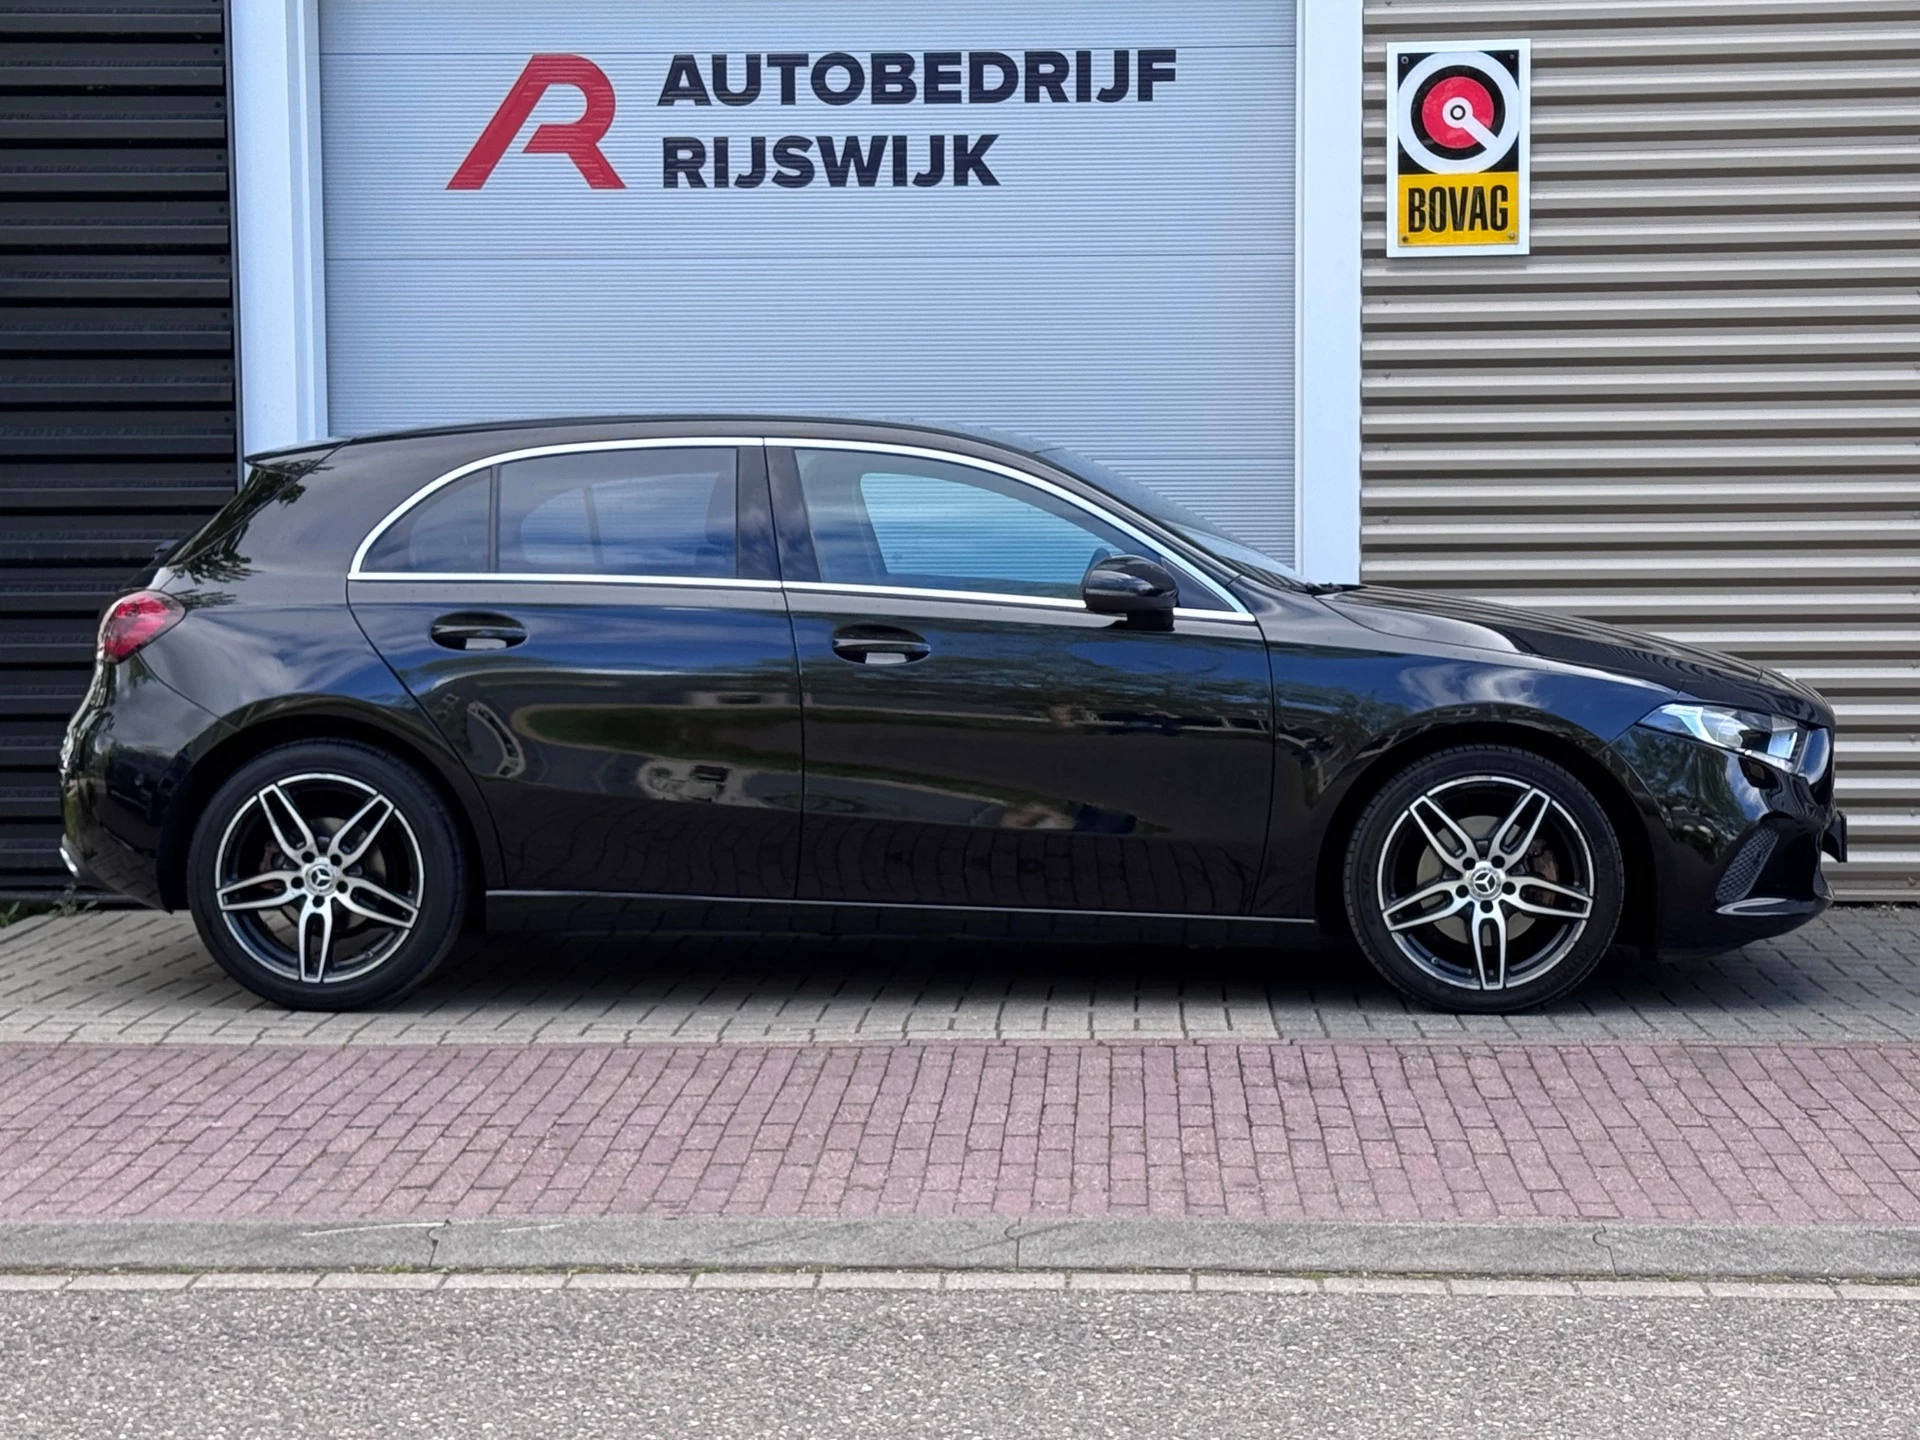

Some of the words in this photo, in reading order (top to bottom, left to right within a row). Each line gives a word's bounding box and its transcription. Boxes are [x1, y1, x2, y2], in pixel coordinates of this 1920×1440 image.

[657, 50, 1176, 107] AUTOBEDRIJF
[663, 134, 1001, 189] RIJSWIJK
[1408, 185, 1508, 233] BOVAG
